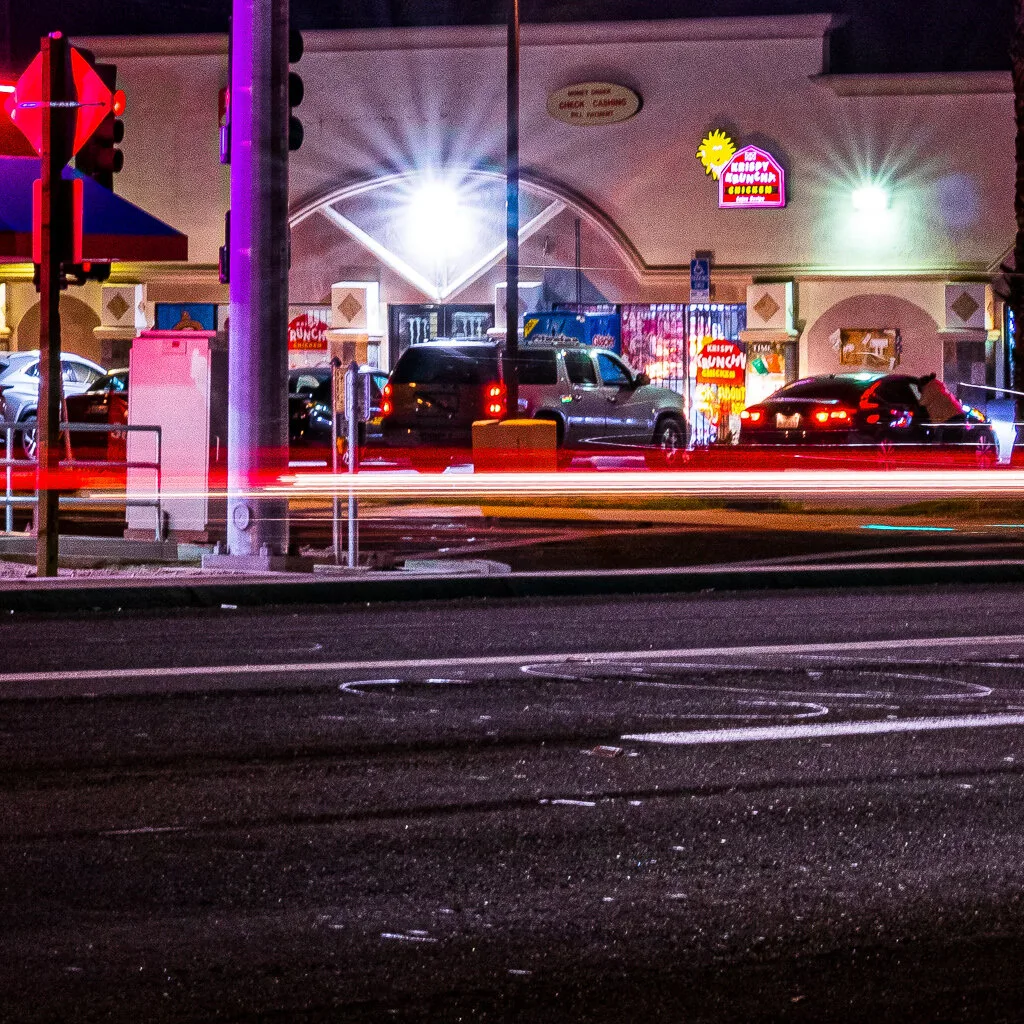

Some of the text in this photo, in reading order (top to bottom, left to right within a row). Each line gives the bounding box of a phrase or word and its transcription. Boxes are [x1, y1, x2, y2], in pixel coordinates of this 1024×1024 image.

[731, 161, 769, 173] KRISPY
[728, 185, 772, 195] CHICKEN
[287, 326, 327, 342] RUNCH
[706, 344, 734, 353] KRISPY
